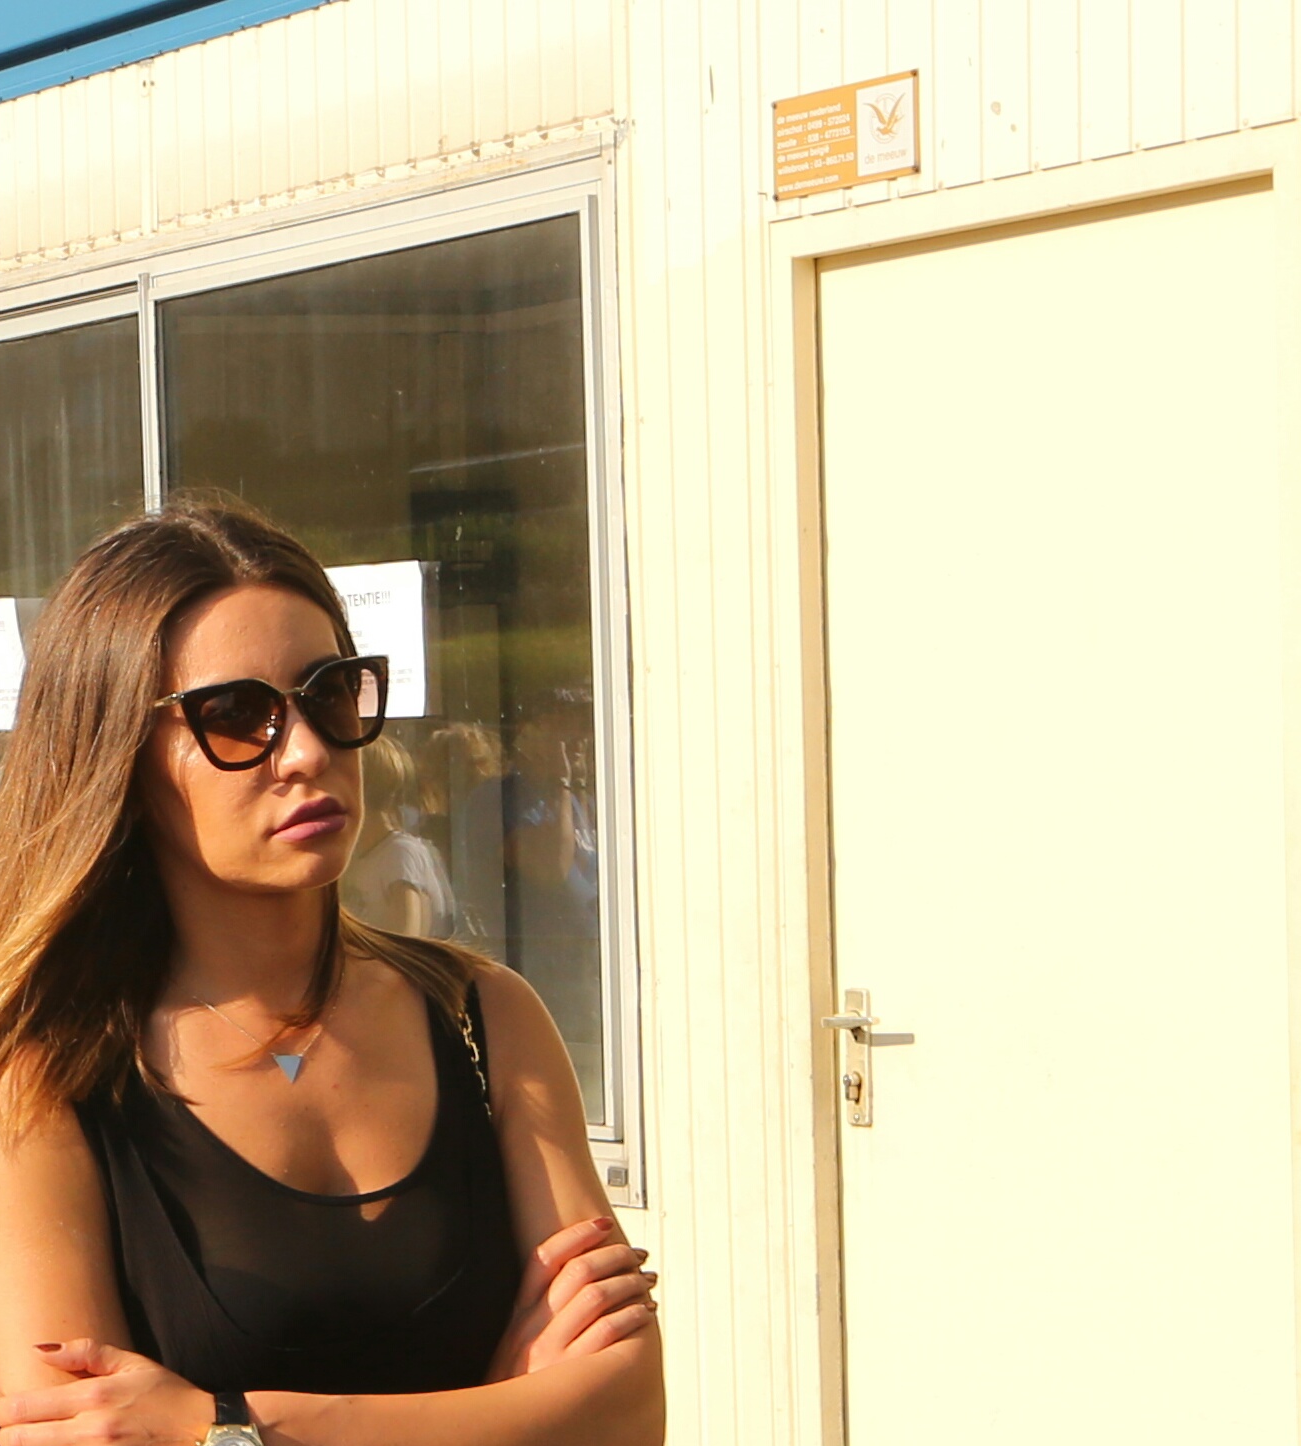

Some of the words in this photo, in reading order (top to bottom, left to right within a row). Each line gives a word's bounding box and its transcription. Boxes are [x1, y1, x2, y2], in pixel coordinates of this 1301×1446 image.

[864, 152, 876, 165] de
[877, 148, 907, 162] meeuw
[341, 590, 391, 608] TENȚIE!!!
